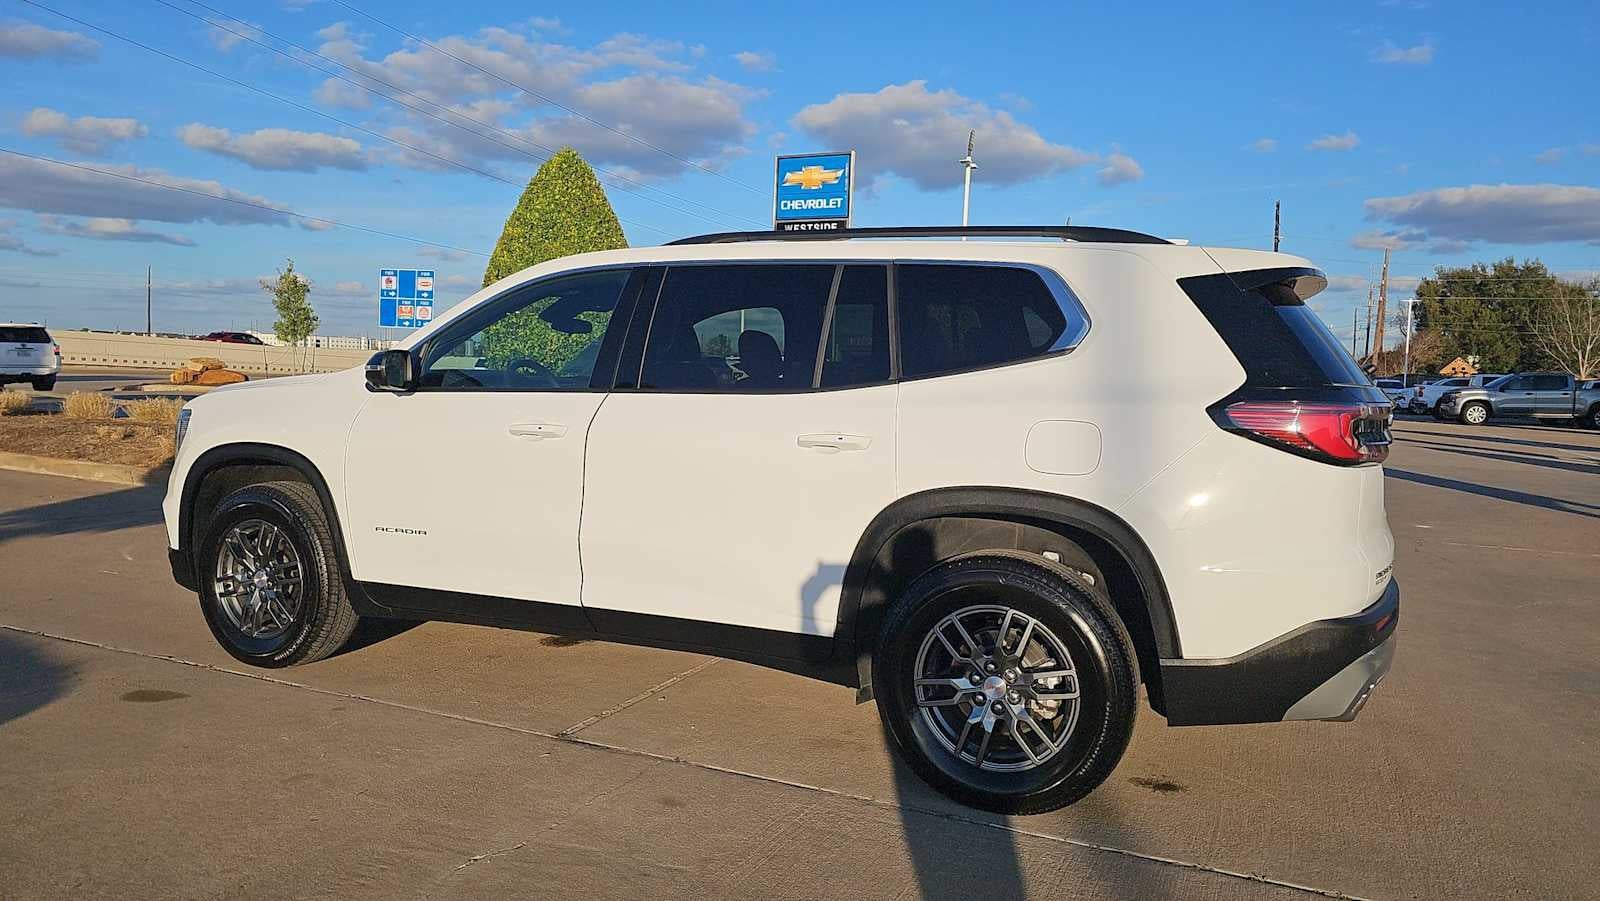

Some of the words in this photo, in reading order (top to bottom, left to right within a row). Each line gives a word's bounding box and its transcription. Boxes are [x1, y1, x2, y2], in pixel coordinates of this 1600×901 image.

[780, 198, 843, 210] CHEVROLET
[784, 222, 838, 231] WESTSIDE
[375, 526, 427, 535] ACADIA
